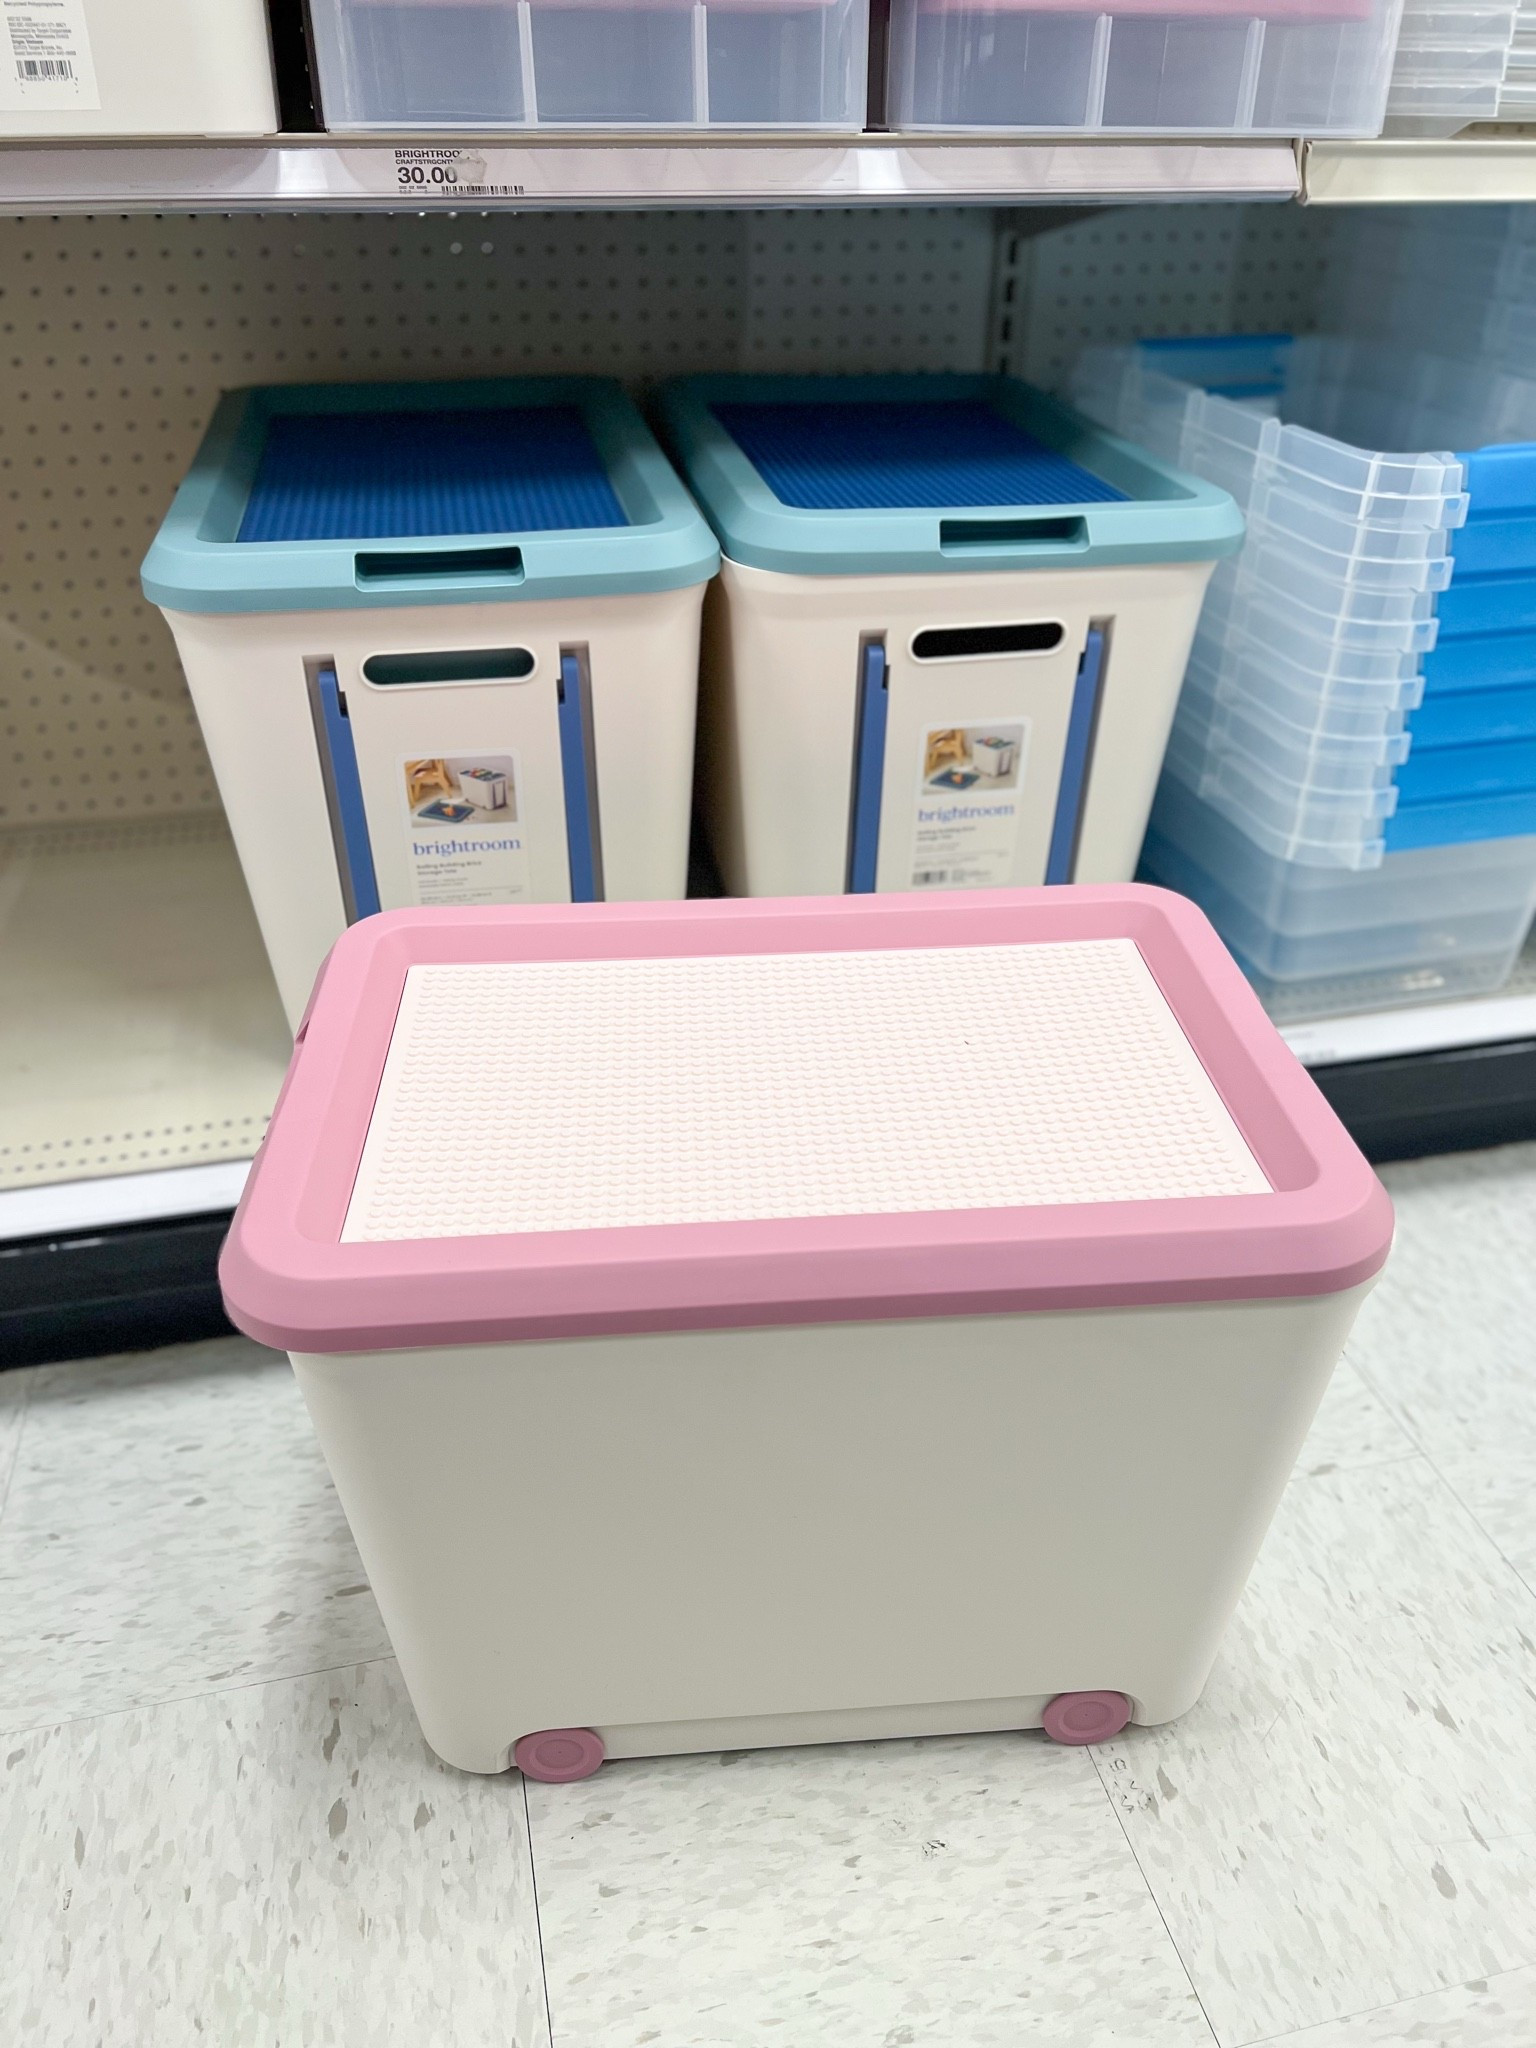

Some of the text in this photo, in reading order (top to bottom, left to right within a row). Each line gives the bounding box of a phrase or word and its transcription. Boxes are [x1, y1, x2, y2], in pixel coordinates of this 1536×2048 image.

[394, 149, 462, 158] BRIGHTROO
[397, 166, 458, 184] 30.00
[918, 804, 1015, 823] brightroom
[413, 839, 521, 858] brightroom
